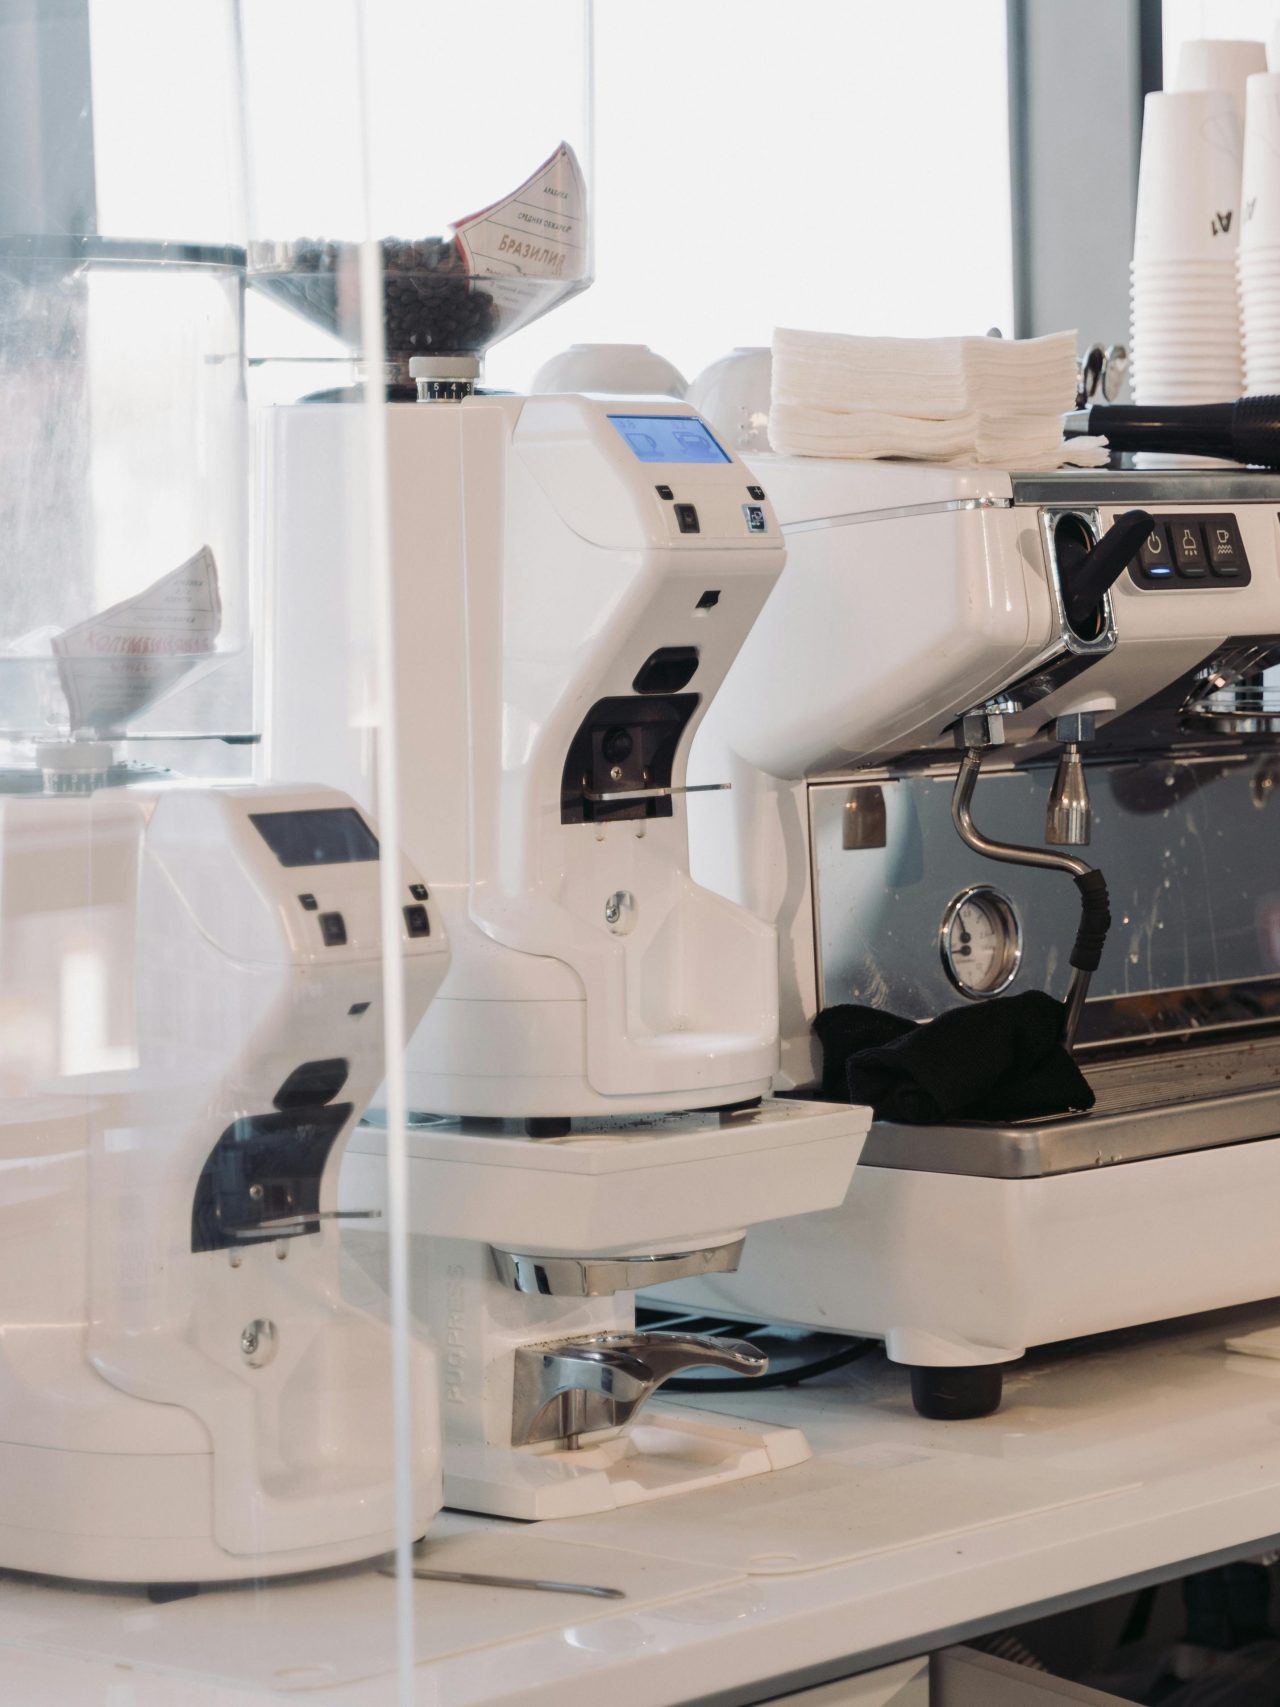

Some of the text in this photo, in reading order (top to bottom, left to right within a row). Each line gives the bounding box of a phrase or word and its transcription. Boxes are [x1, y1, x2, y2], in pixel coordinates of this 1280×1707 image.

[1211, 210, 1232, 236] A1
[499, 234, 567, 270] БРАЗИЛИЯ
[433, 383, 471, 392] 5 4 3
